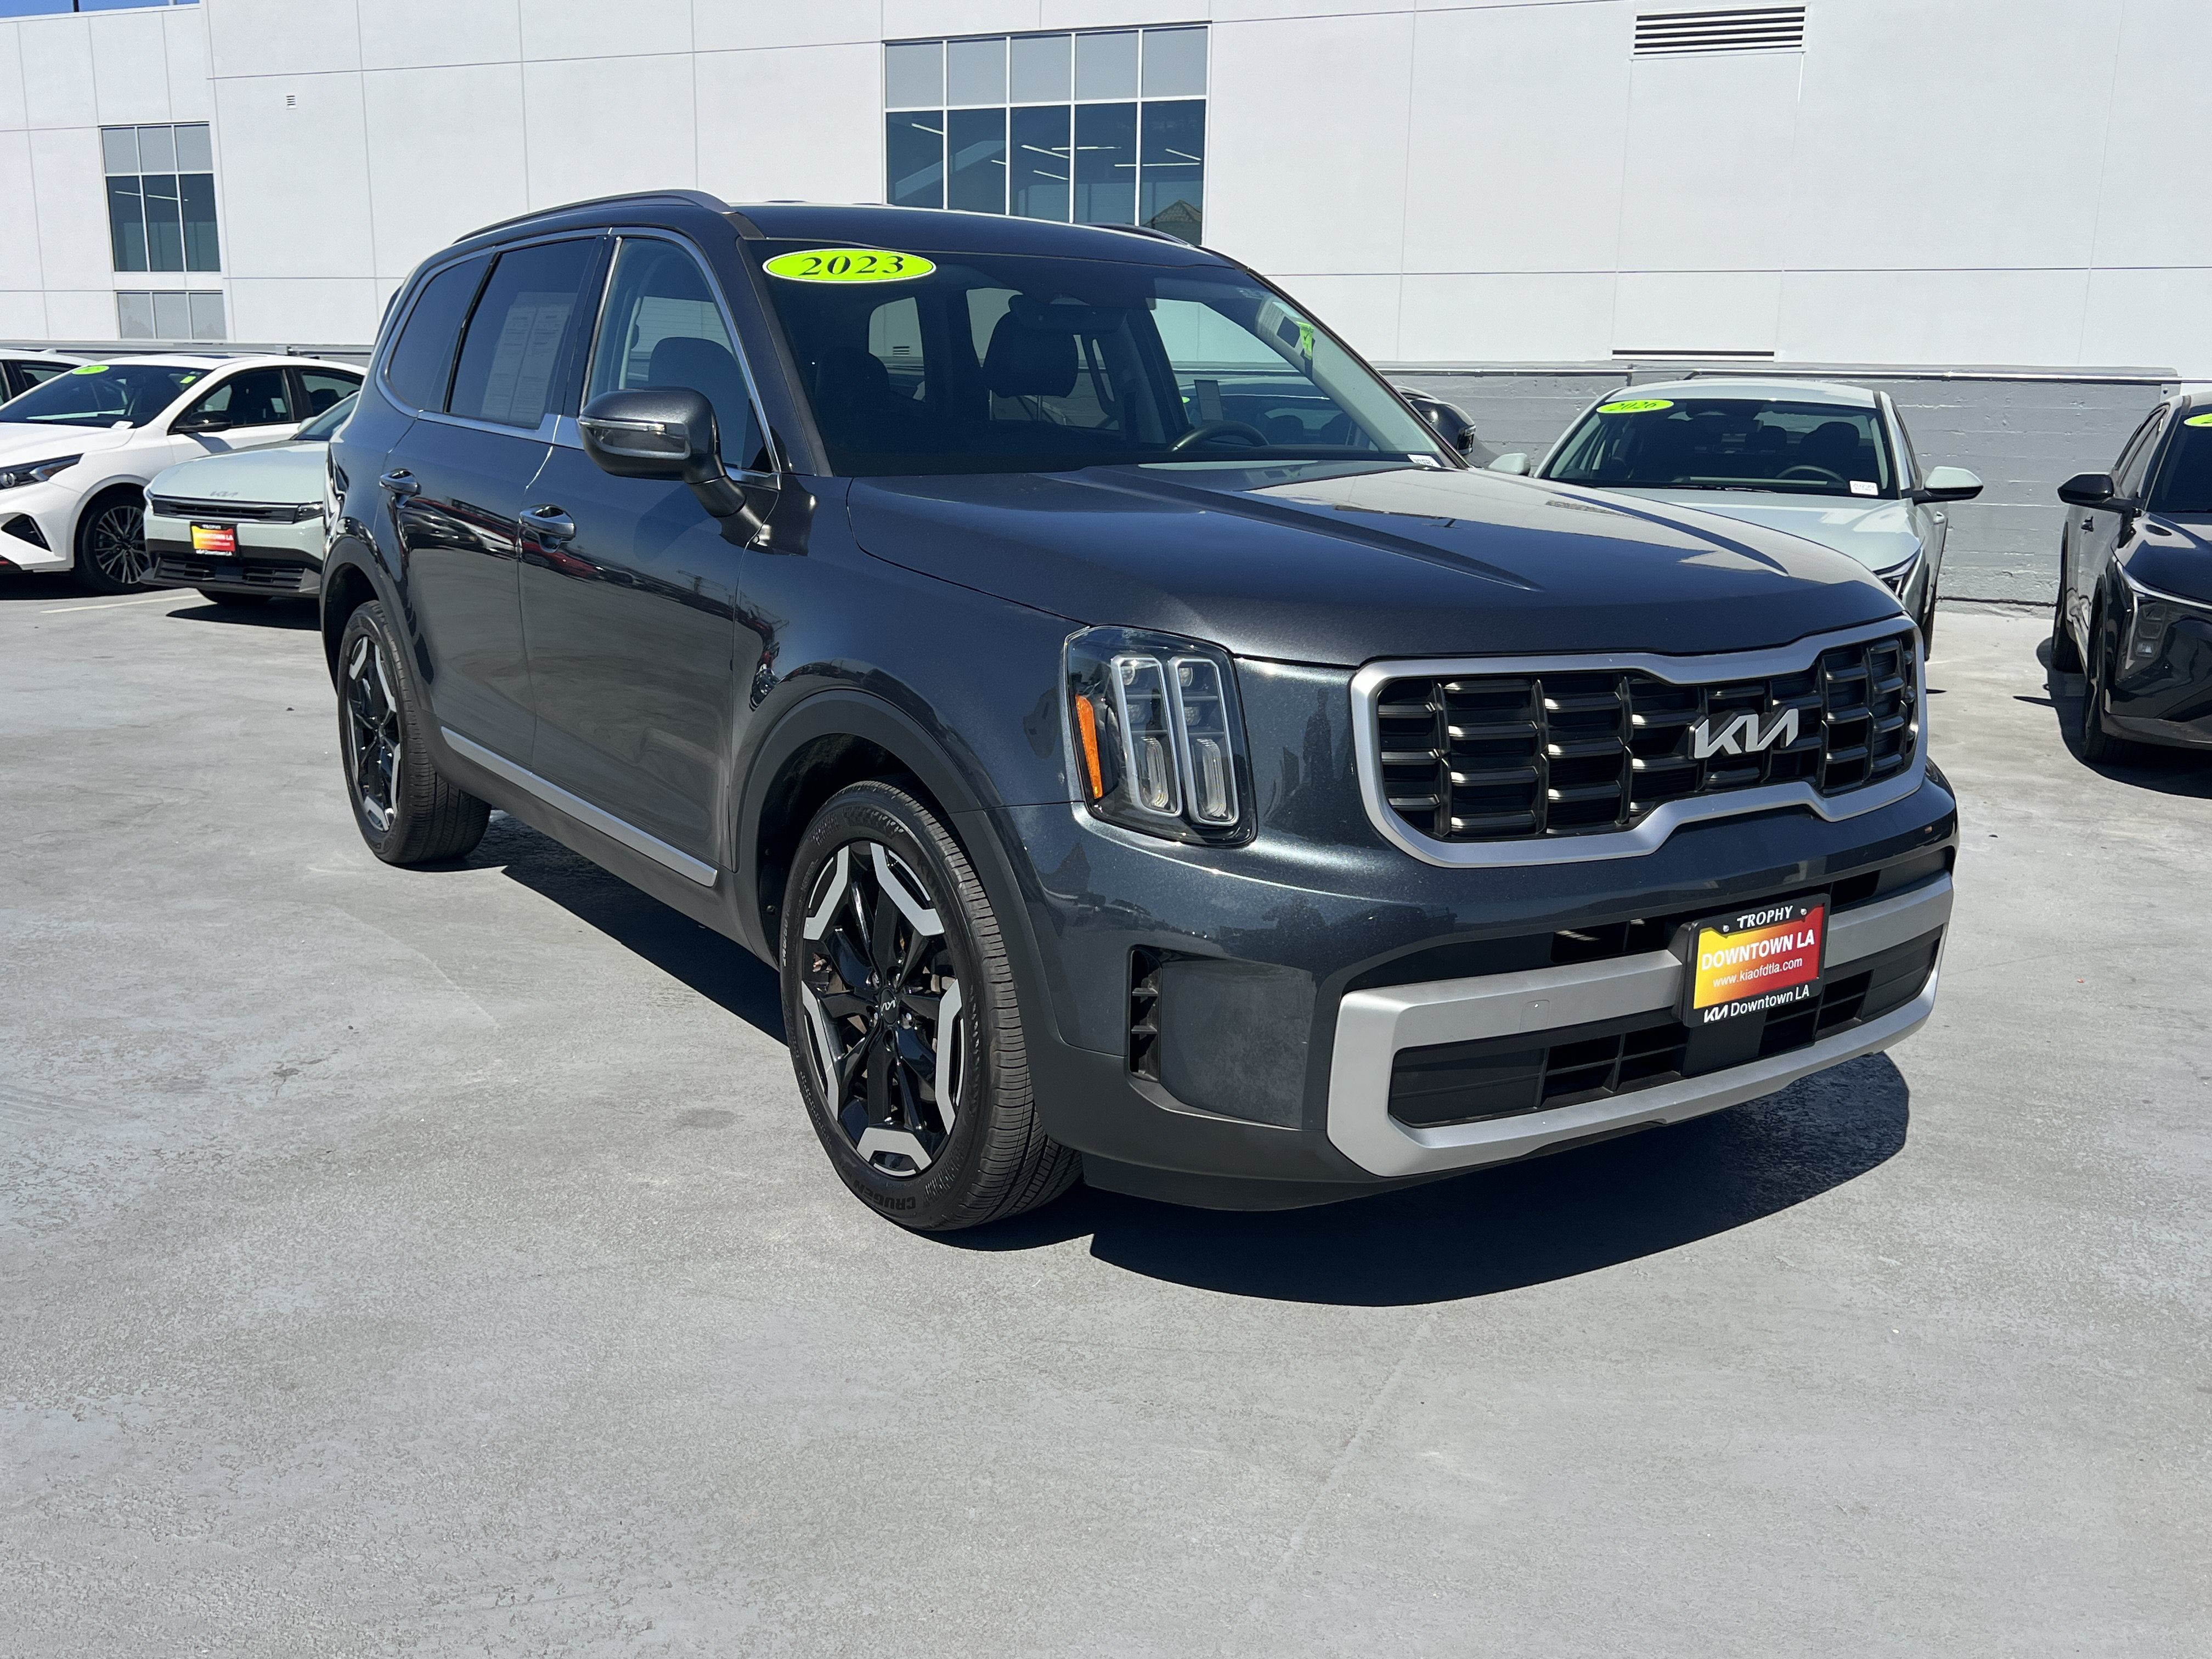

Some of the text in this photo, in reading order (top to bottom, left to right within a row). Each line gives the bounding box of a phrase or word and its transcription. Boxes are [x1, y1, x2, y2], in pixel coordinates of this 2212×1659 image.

[798, 255, 904, 276] 2023
[1694, 708, 1799, 759] KIA
[1737, 905, 1793, 929] TROPHY
[1701, 929, 1815, 970] DOWNTOWN LA
[1713, 957, 1803, 988] www.kiaofdtla.com
[1703, 984, 1809, 1023] KIA Downtown LA
[853, 1180, 916, 1210] CRUGEN
